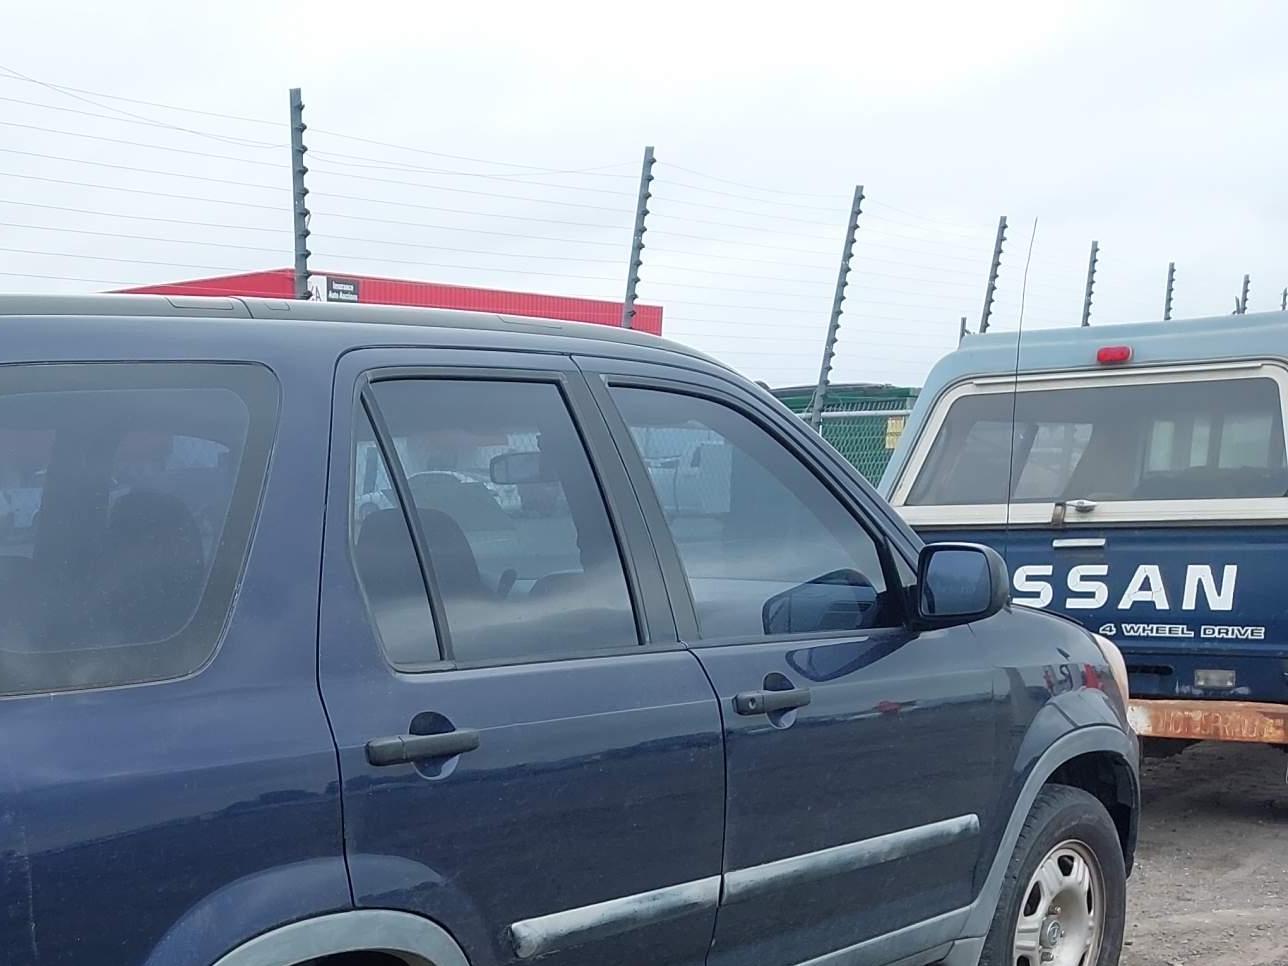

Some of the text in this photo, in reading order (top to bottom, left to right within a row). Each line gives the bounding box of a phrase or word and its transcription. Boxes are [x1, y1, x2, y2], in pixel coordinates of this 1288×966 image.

[1012, 564, 1238, 611] SSAN
[1099, 623, 1265, 640] 4 WHEEL DRIVE
